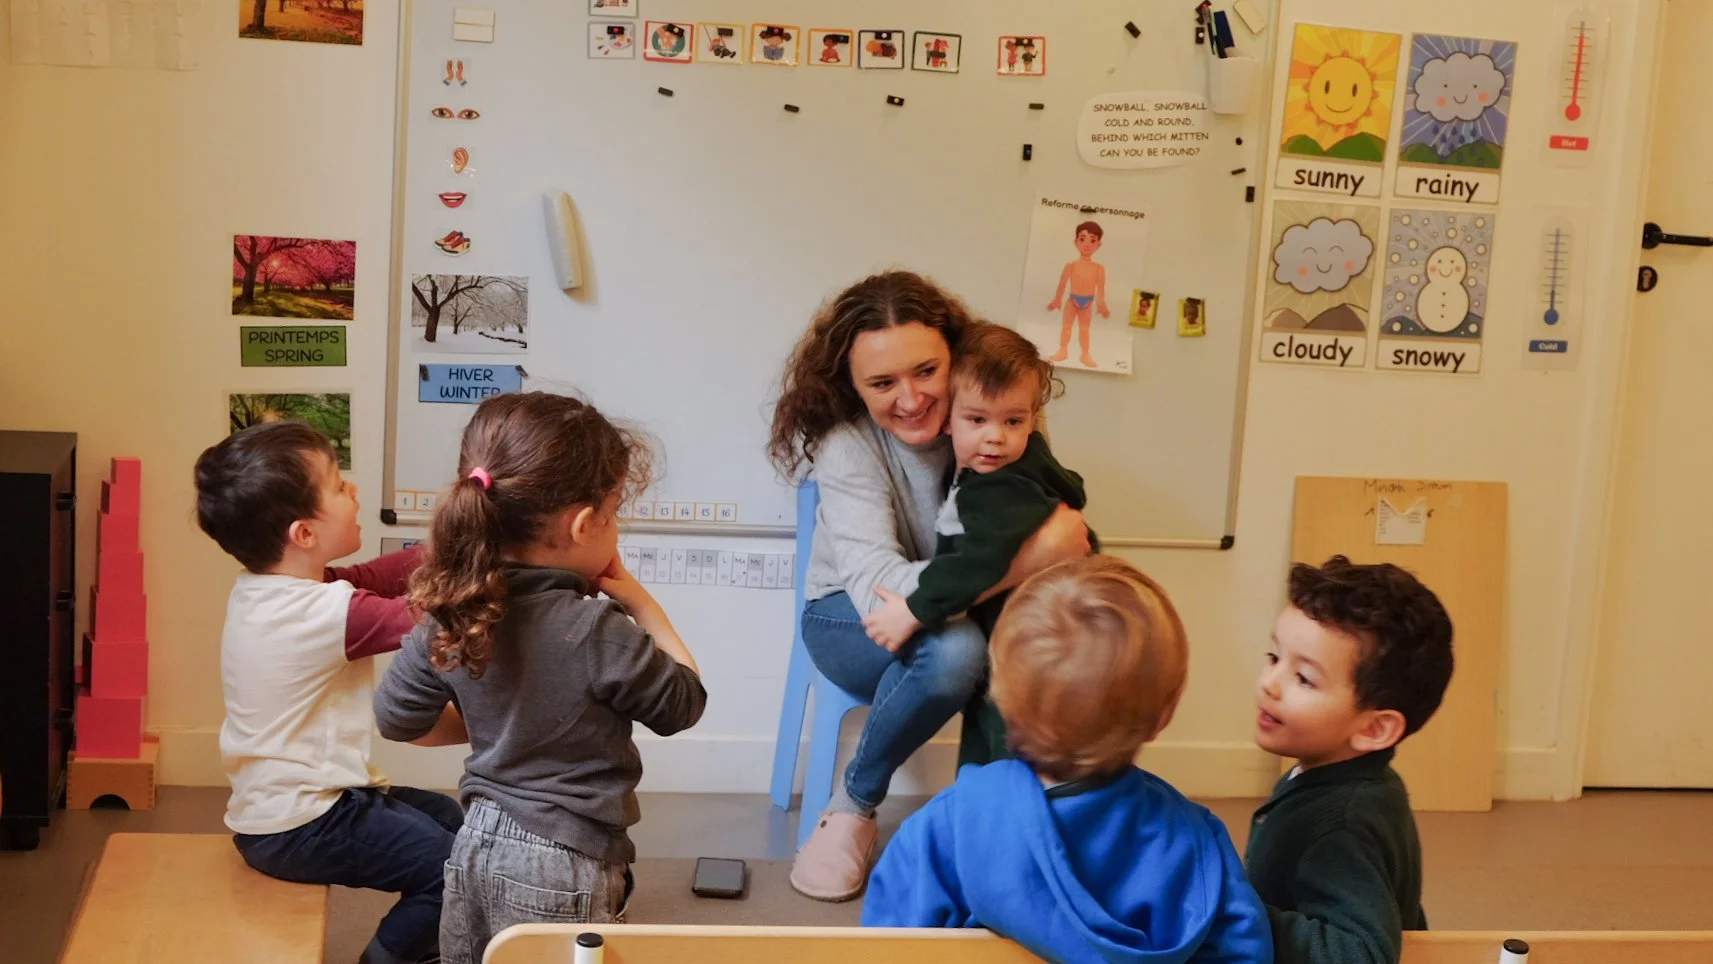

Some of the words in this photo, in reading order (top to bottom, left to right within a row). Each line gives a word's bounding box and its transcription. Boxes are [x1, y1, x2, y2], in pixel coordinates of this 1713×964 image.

[1104, 118, 1130, 127] COLD
[1133, 118, 1154, 127] AND
[1091, 133, 1129, 143] BEHIND
[1133, 132, 1167, 141] WHICH
[1170, 131, 1209, 141] MITTEN
[1100, 149, 1120, 157] CAN
[1124, 148, 1143, 157] YOU
[1147, 148, 1159, 157] BE
[1162, 147, 1201, 156] FOUND?
[1293, 168, 1365, 197] sunny
[1415, 173, 1480, 203] rainy
[1041, 197, 1079, 211] Reforme
[249, 330, 339, 345] PRINTEMPS
[265, 348, 324, 363] SPRING
[1273, 335, 1354, 367] cloudy
[1392, 347, 1466, 374] snowy
[448, 367, 494, 382] HIVER
[660, 507, 670, 517] 13
[681, 507, 690, 517] 14
[702, 507, 710, 517] 15
[721, 508, 731, 518] 16
